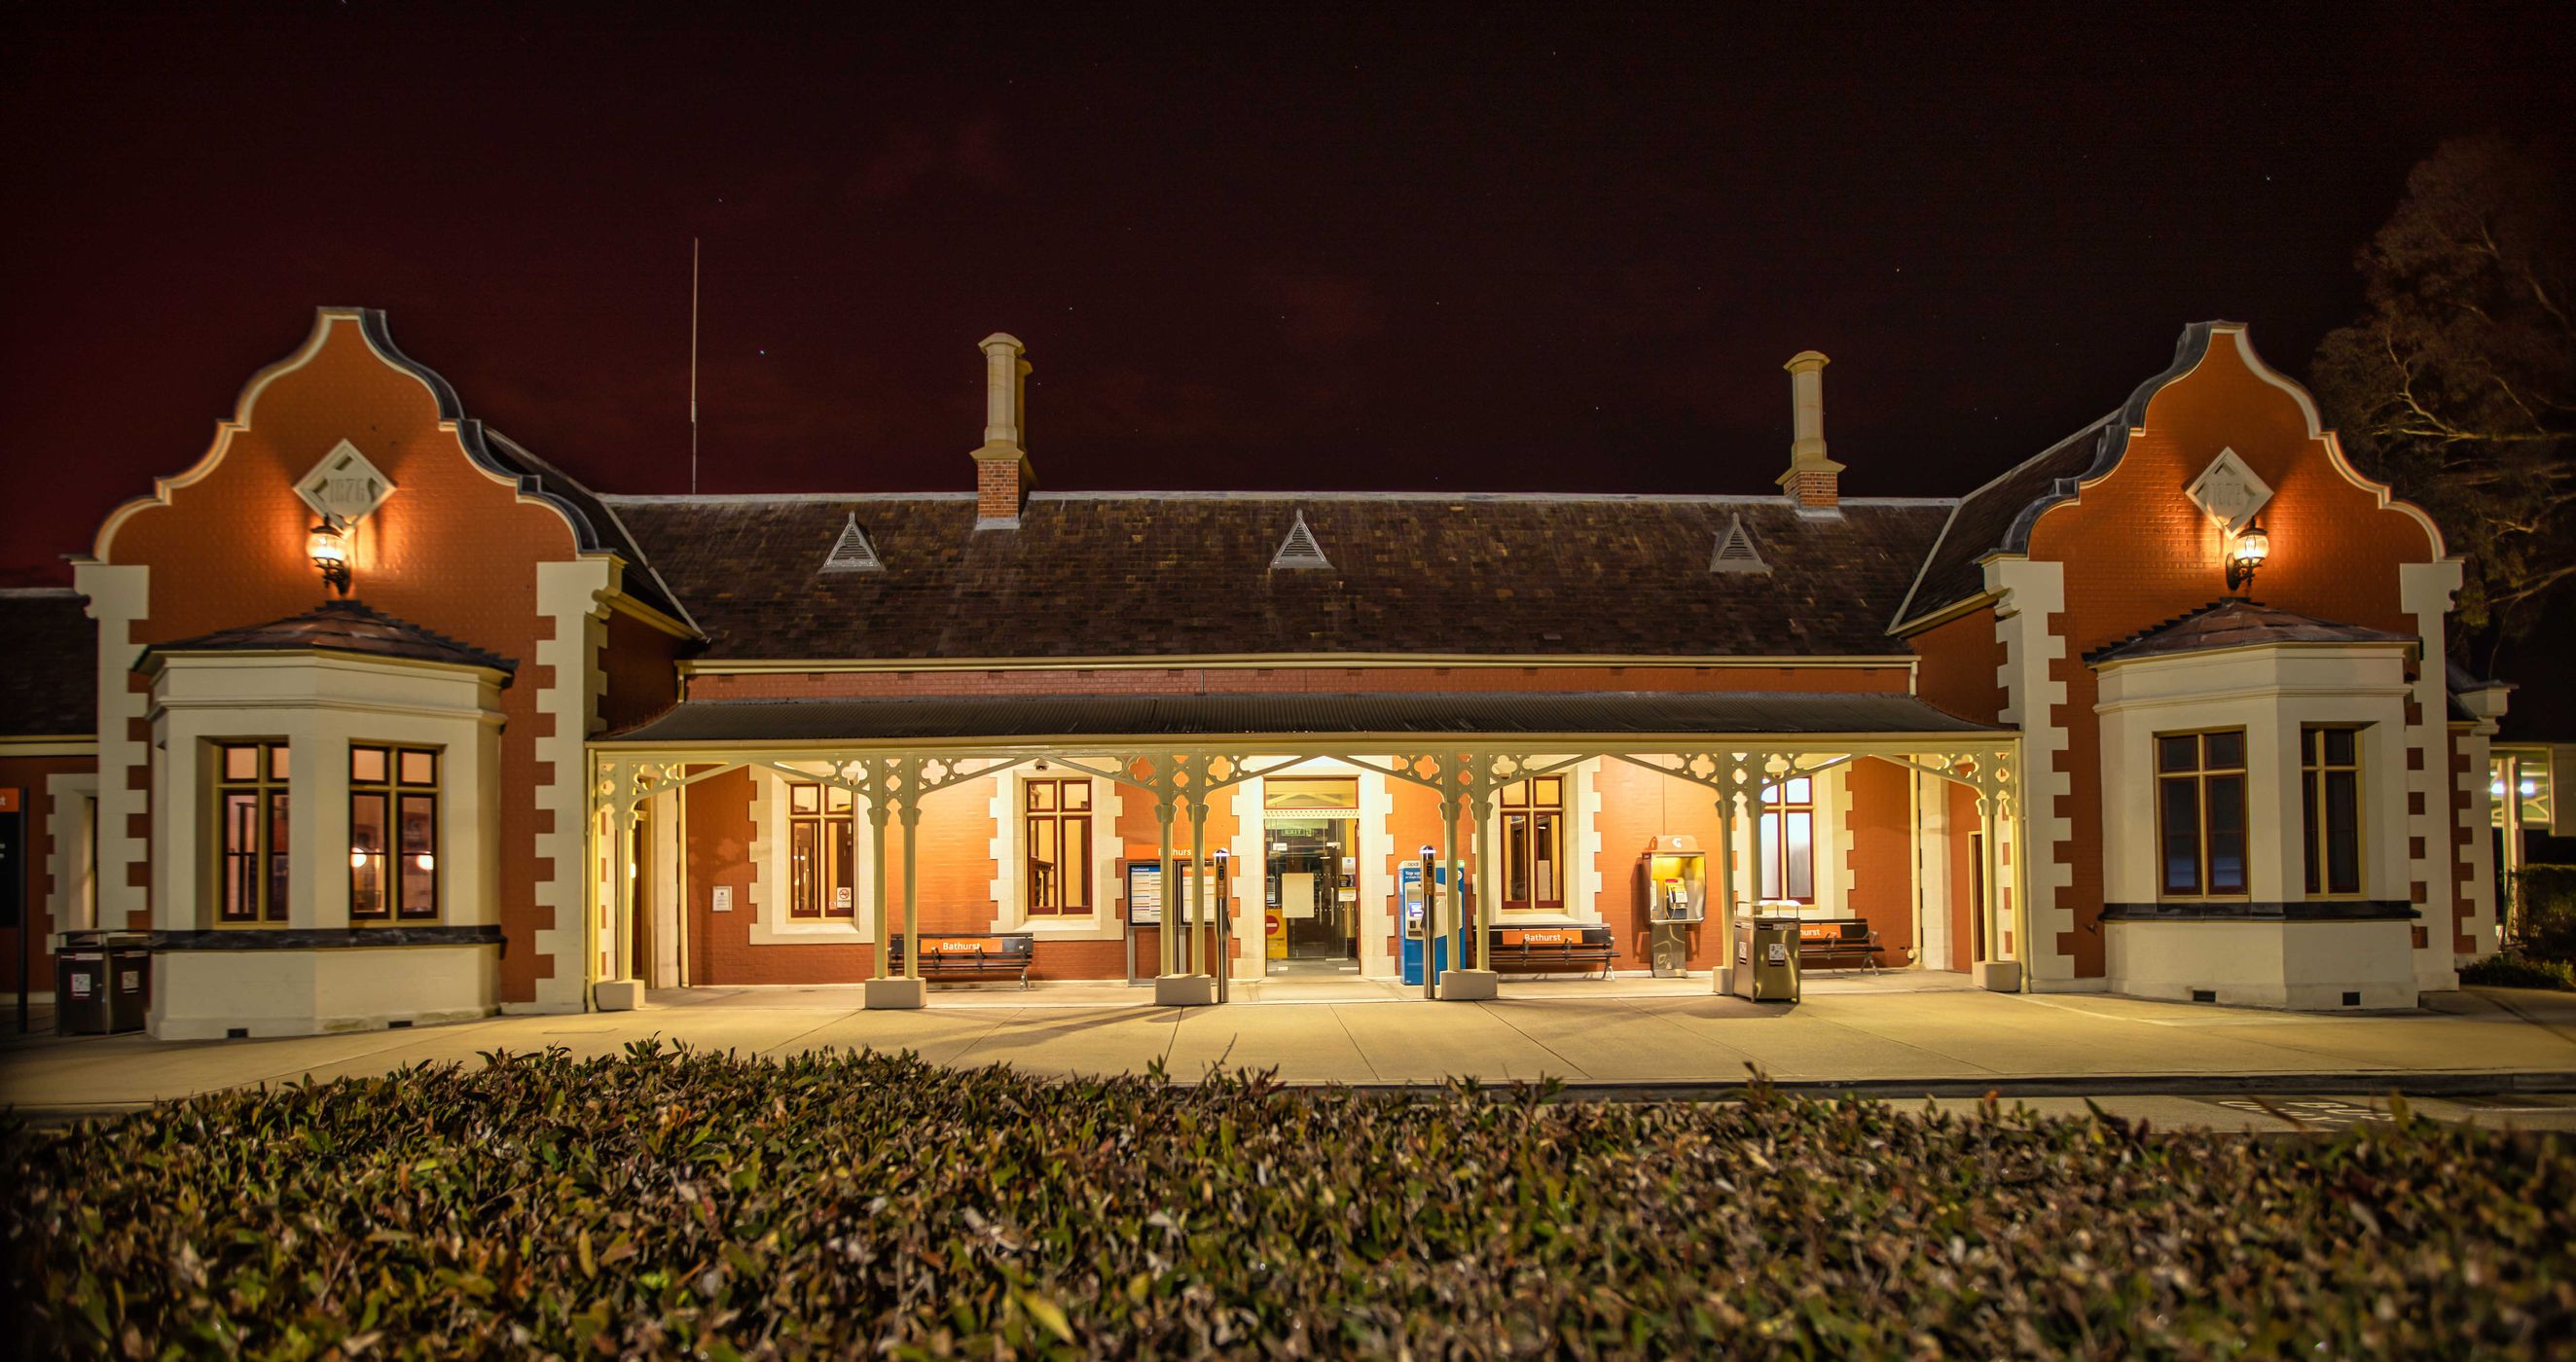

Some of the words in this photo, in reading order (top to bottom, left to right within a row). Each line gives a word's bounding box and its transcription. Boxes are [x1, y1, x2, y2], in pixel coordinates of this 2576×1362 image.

[1158, 847, 1192, 856] Bhurs
[1524, 933, 1561, 942] Bathurst
[942, 942, 981, 950] Bathurst
